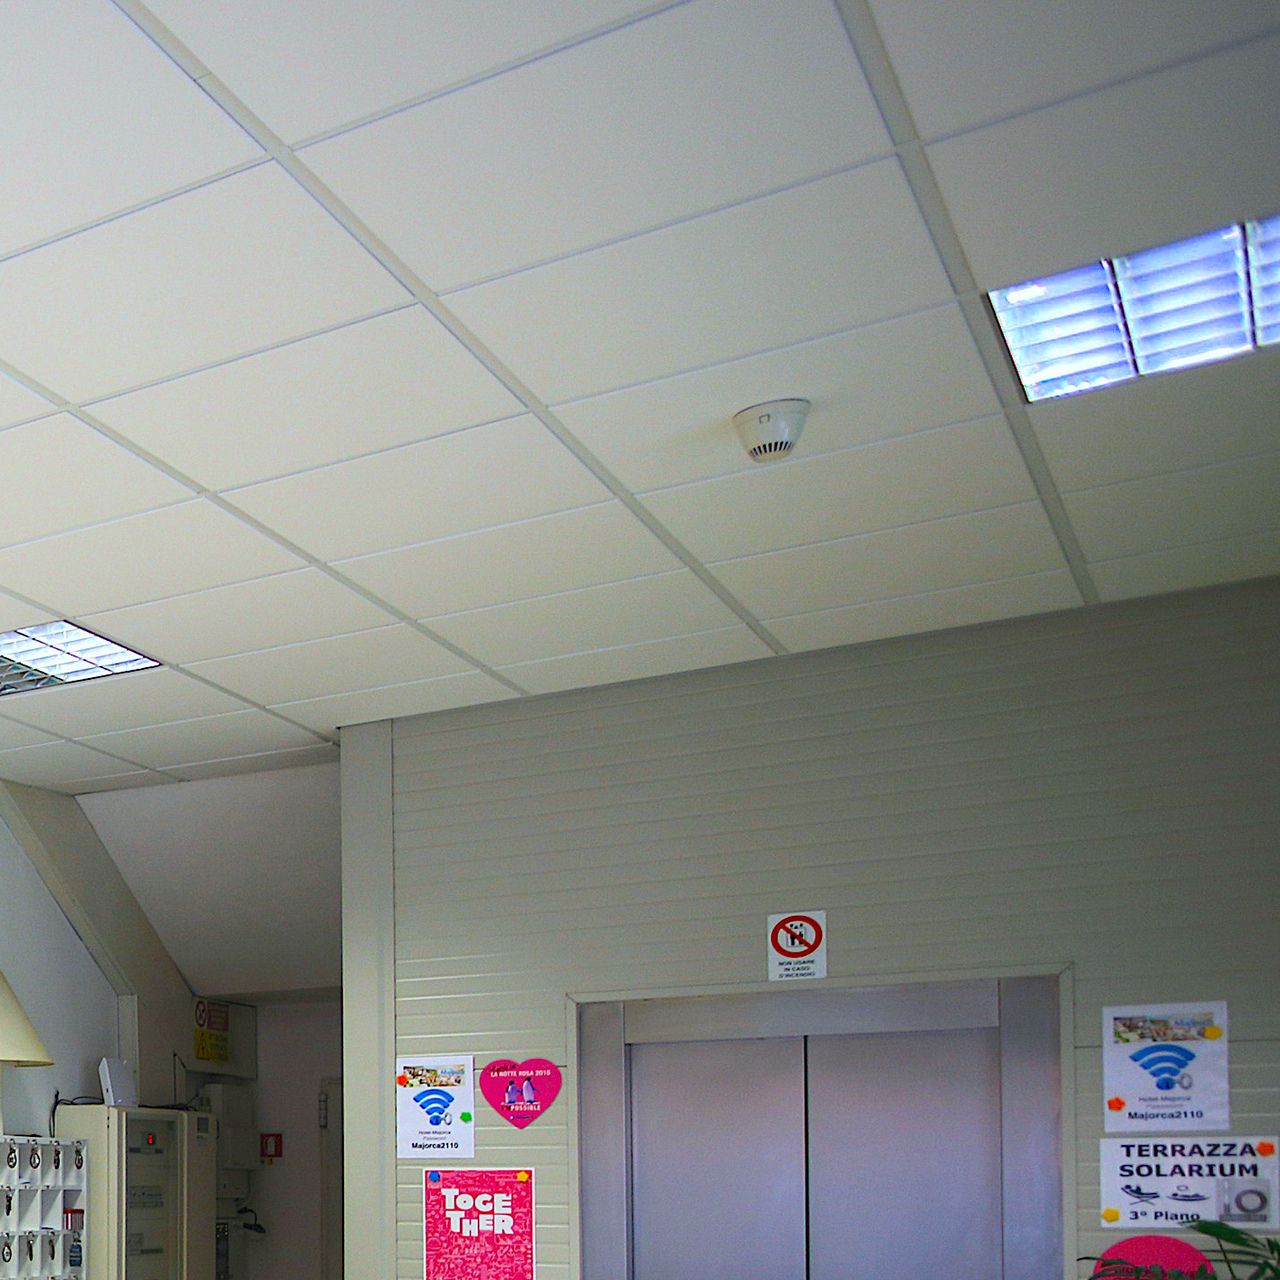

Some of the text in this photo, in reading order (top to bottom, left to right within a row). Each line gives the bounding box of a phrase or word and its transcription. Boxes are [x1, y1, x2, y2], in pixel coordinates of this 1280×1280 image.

[1128, 1111, 1203, 1120] Majorca2110
[412, 1142, 459, 1150] Majorca2110
[1121, 1144, 1256, 1157] TERRAZZA
[1119, 1164, 1258, 1177] SOLARIUM
[441, 1188, 512, 1214] TOGE
[1154, 1211, 1200, 1221] Piano
[446, 1210, 514, 1236] THER
